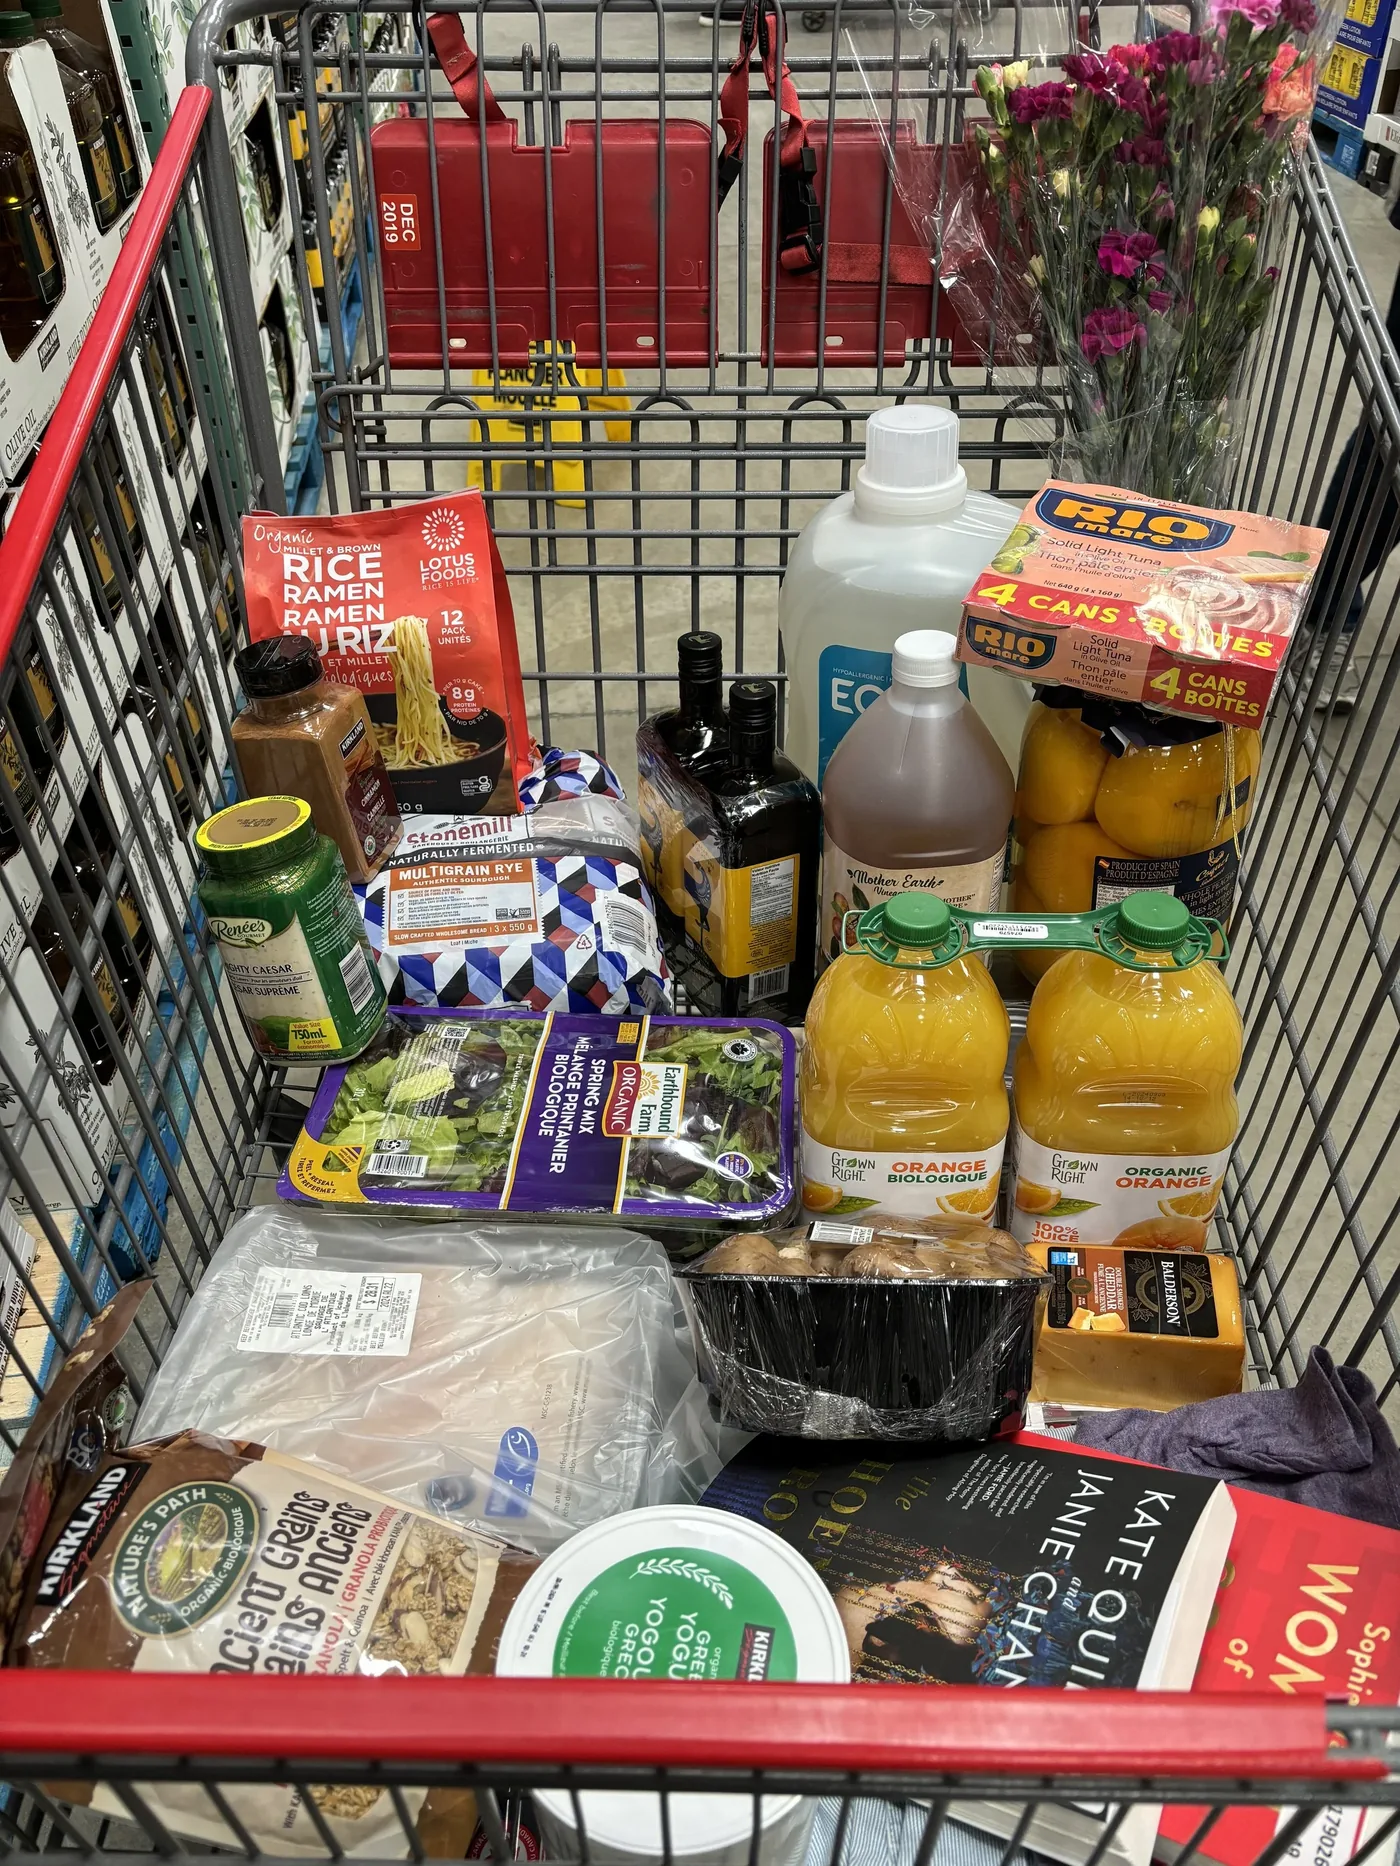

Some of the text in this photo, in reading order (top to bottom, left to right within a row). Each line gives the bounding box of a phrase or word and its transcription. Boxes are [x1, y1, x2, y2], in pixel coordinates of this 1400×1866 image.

[383, 201, 399, 243] 2019
[401, 203, 416, 243] DEC
[1054, 498, 1210, 541] RIO
[254, 525, 315, 552] Organic
[1074, 521, 1173, 546] mare
[284, 543, 381, 556] MILLET & BROWN
[1041, 551, 1075, 565] Thon
[1078, 558, 1110, 572] pâle
[1047, 537, 1162, 567] Solid Light Tuna
[283, 552, 383, 583] RICE
[419, 553, 475, 572] LOTUS
[1050, 562, 1073, 572] dans
[1104, 570, 1136, 582] d'olive
[420, 566, 476, 584] FOODS
[422, 580, 454, 592] RICE IS
[284, 581, 384, 605] RAMEN
[1044, 579, 1112, 596] Net 640 160
[284, 603, 385, 628] RAMEN
[440, 610, 464, 626] 12
[977, 583, 1275, 658] 4 CANS BOTES
[336, 624, 398, 655] RIZ
[438, 633, 472, 646] UNITÉS
[442, 625, 466, 636] PACK
[973, 624, 1047, 657] RIO
[1090, 634, 1119, 650] Solid
[328, 654, 390, 668] ET MILLET
[985, 646, 1031, 664] mare
[1073, 641, 1132, 663] Light Tuna
[1089, 654, 1109, 665] Olive
[1110, 658, 1121, 668] Oil
[324, 669, 394, 687] iologiques
[832, 667, 885, 682] HYPOALLERGENIC
[1071, 659, 1127, 681] Thon pâle
[1081, 672, 1114, 686] entier
[1064, 676, 1129, 696] dans l'huile d'olive
[1150, 666, 1247, 700] 4 CANS
[1183, 689, 1262, 717] BOÎTES
[341, 722, 364, 753] KIRKLAND
[361, 779, 381, 807] CINNAMON
[366, 795, 386, 822] CANNELLE
[406, 816, 514, 845] Stonemill
[388, 843, 534, 867] NATURALLY FERMENTED
[1111, 860, 1181, 872] PRODUCT OF SPAIN
[399, 863, 524, 881] MULTIGRAIN RYE
[412, 875, 510, 886] AUTHENTIC SOURDOUGH
[853, 869, 938, 889] Mother Earth
[1105, 869, 1180, 880] PRODUIT D'ESPAGNE
[211, 919, 266, 941] Renée's
[394, 933, 409, 941] SLOW
[410, 931, 434, 939] CRAFTED
[436, 929, 469, 937] WHOLESOME
[509, 922, 525, 931] 550
[252, 964, 293, 975] CAESAR
[291, 1028, 327, 1040] 750mL
[538, 1054, 570, 1137] BIOLOGIQUE
[549, 1036, 593, 1174] MÉLANGE PRINTANIER
[578, 1059, 607, 1135] SPRING MIX
[610, 1066, 637, 1130] ORGANIC
[657, 1066, 681, 1134] Earthbound
[638, 1103, 657, 1133] Farm
[887, 1171, 987, 1184] BIOLOGIQUE
[892, 1159, 987, 1174] ORANGE
[1125, 1166, 1208, 1177] ORGANIC
[300, 1179, 337, 1194] REFERMEZ
[309, 1175, 335, 1187] RESEAL
[1115, 1175, 1213, 1189] ORANGE
[1031, 1230, 1080, 1243] JUICE
[1035, 1221, 1080, 1235] 100%
[1104, 1266, 1118, 1311] CHEDDAR
[1115, 1267, 1125, 1311] DOUBLE SMOKED
[1161, 1260, 1181, 1326] BALDERSON
[323, 1292, 338, 1326] ATLANTIQUE
[1039, 1469, 1114, 1560] JANIE
[39, 1467, 128, 1596] KIRKLAND
[120, 1487, 207, 1619] NATURE'S PATH
[341, 1542, 377, 1603] GRANOLA
[1062, 1489, 1177, 1690] KATE QUI
[1062, 1575, 1083, 1612] and
[334, 1650, 351, 1676] Spelt
[348, 1605, 369, 1638] Quinoa
[366, 1574, 381, 1596] Avec
[374, 1562, 386, 1576] blé
[600, 1619, 622, 1678] biologique
[669, 1612, 699, 1681] YOGU
[1223, 1638, 1254, 1680] of
[1347, 1622, 1391, 1706] Sophie
